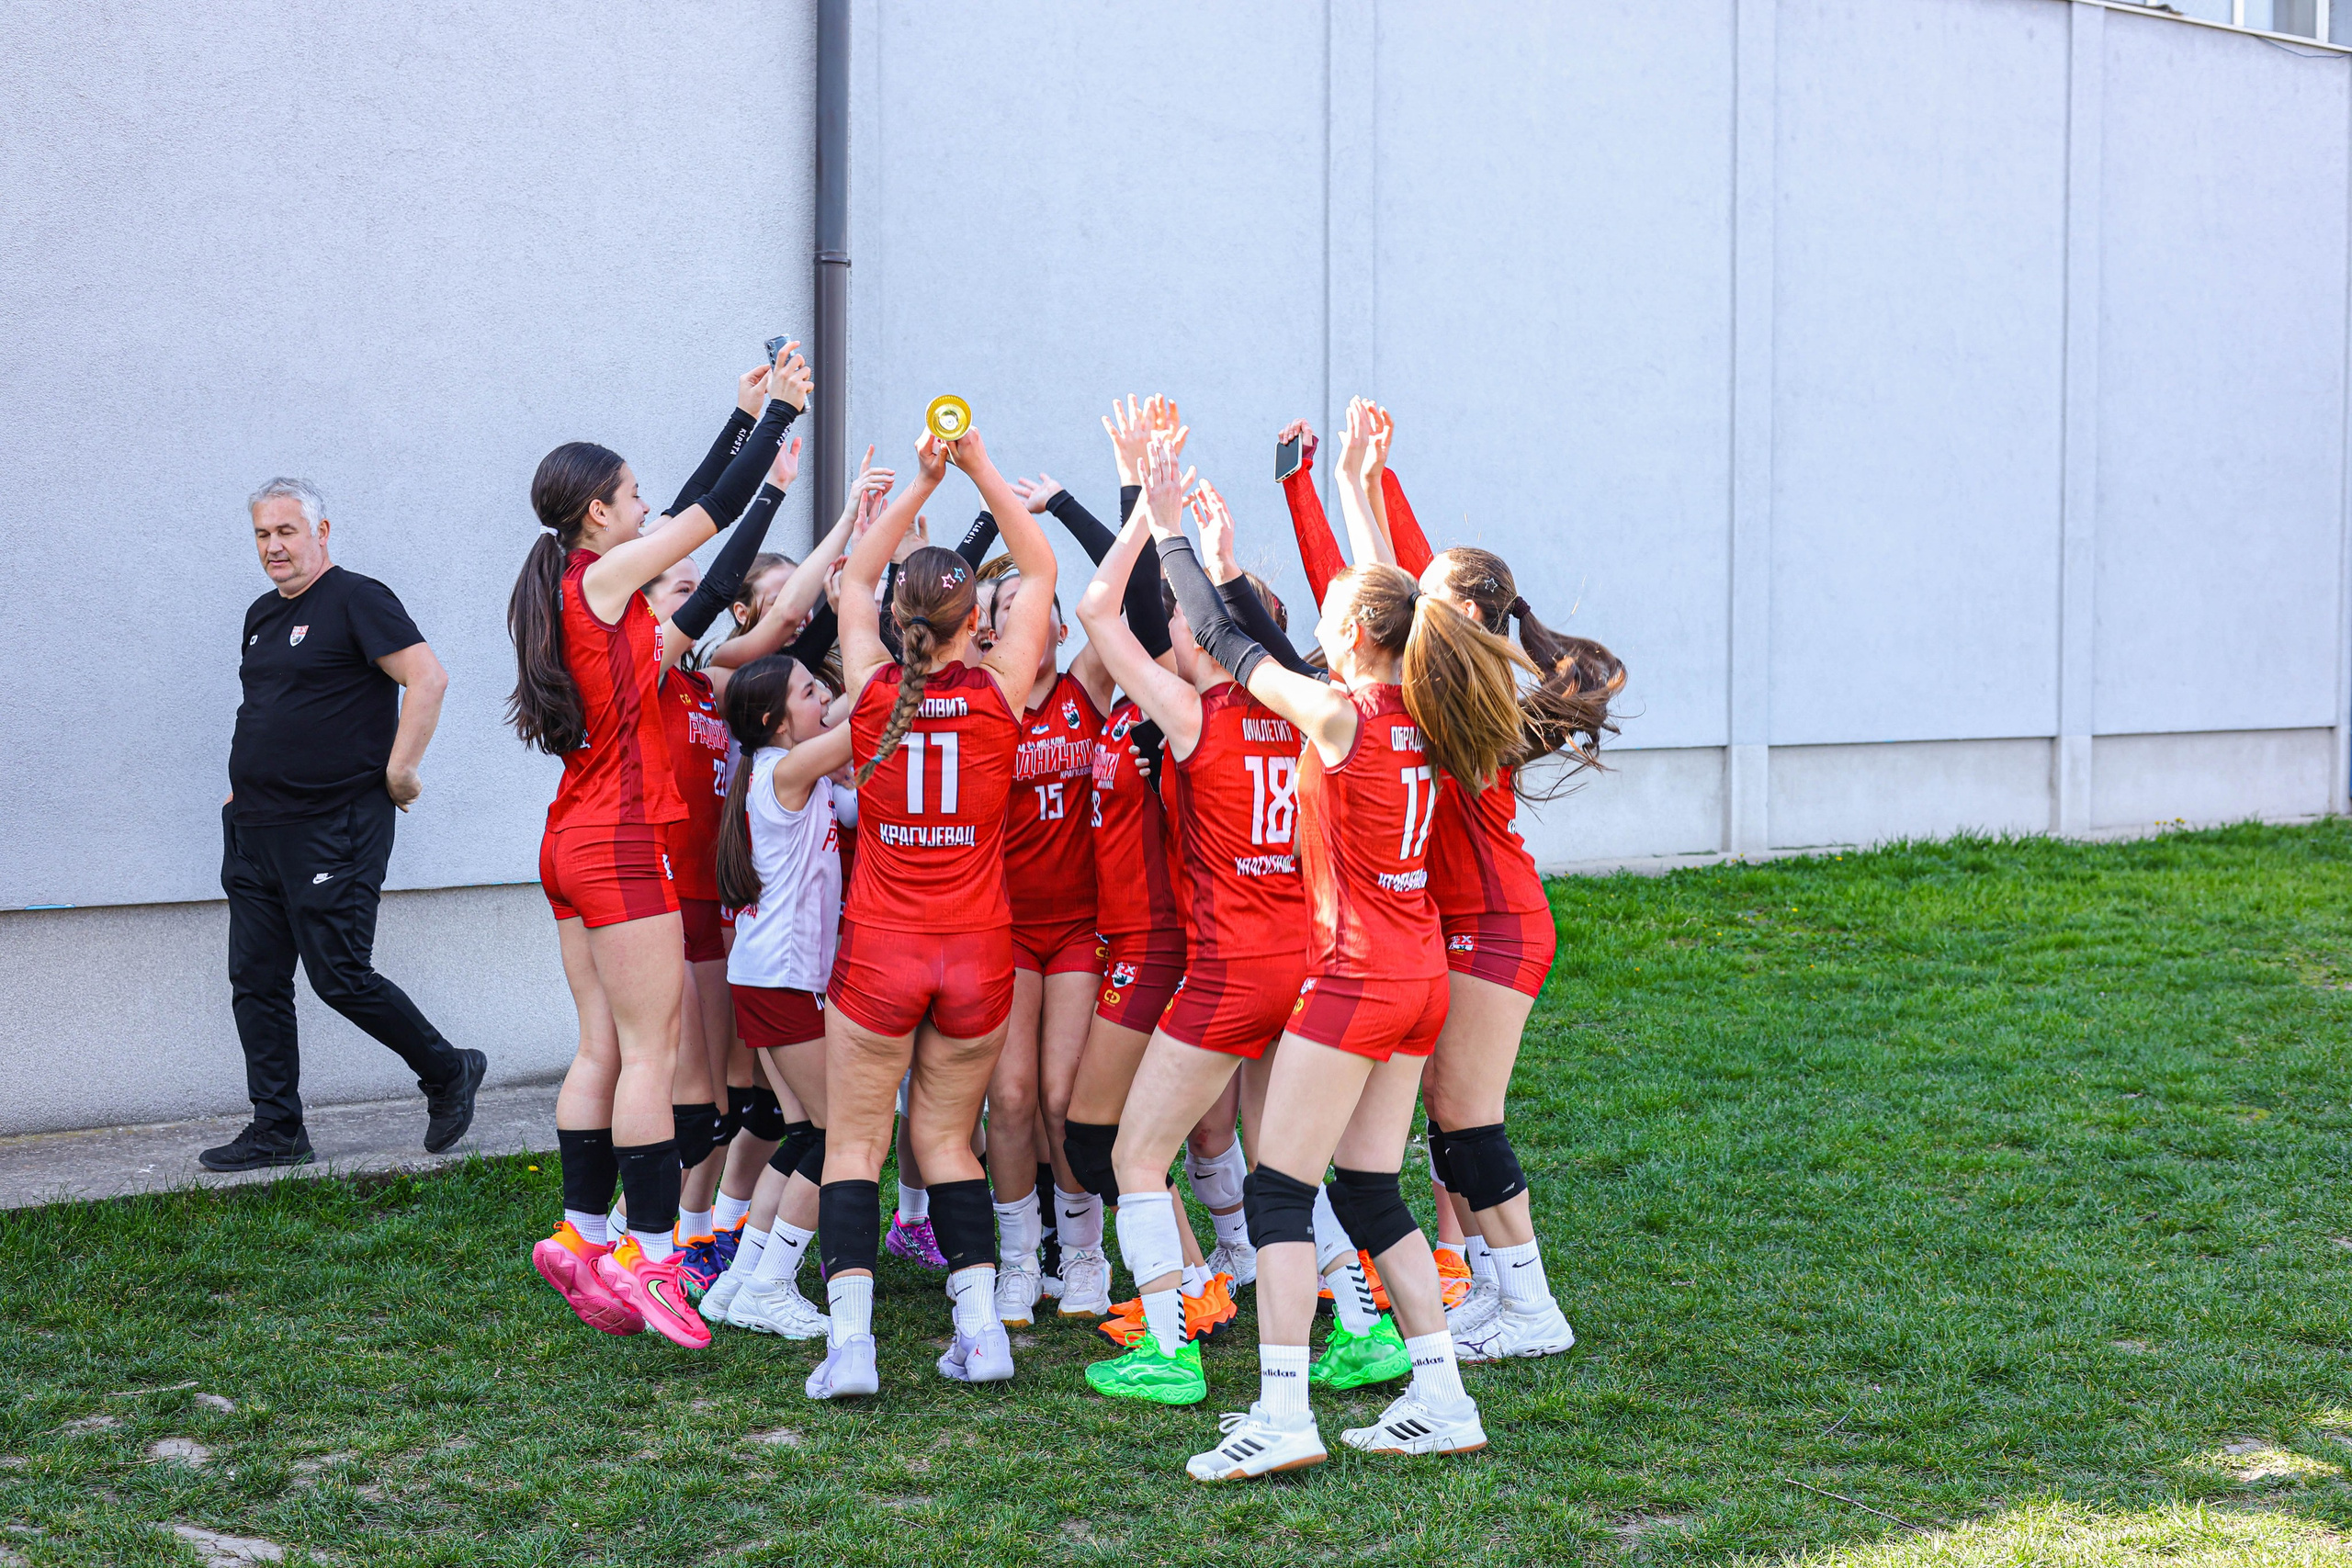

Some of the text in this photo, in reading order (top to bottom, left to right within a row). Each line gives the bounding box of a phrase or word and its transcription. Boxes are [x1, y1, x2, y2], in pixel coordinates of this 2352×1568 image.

[729, 428, 747, 456] KIPSTA
[964, 521, 984, 544] KIPSTA
[915, 696, 968, 717] КОВИЋ
[898, 732, 958, 815] 11
[1035, 783, 1064, 820] 15
[1244, 755, 1296, 845] 18
[1399, 764, 1438, 861] 17
[879, 823, 977, 847] КРАГУЈЕВАЦ
